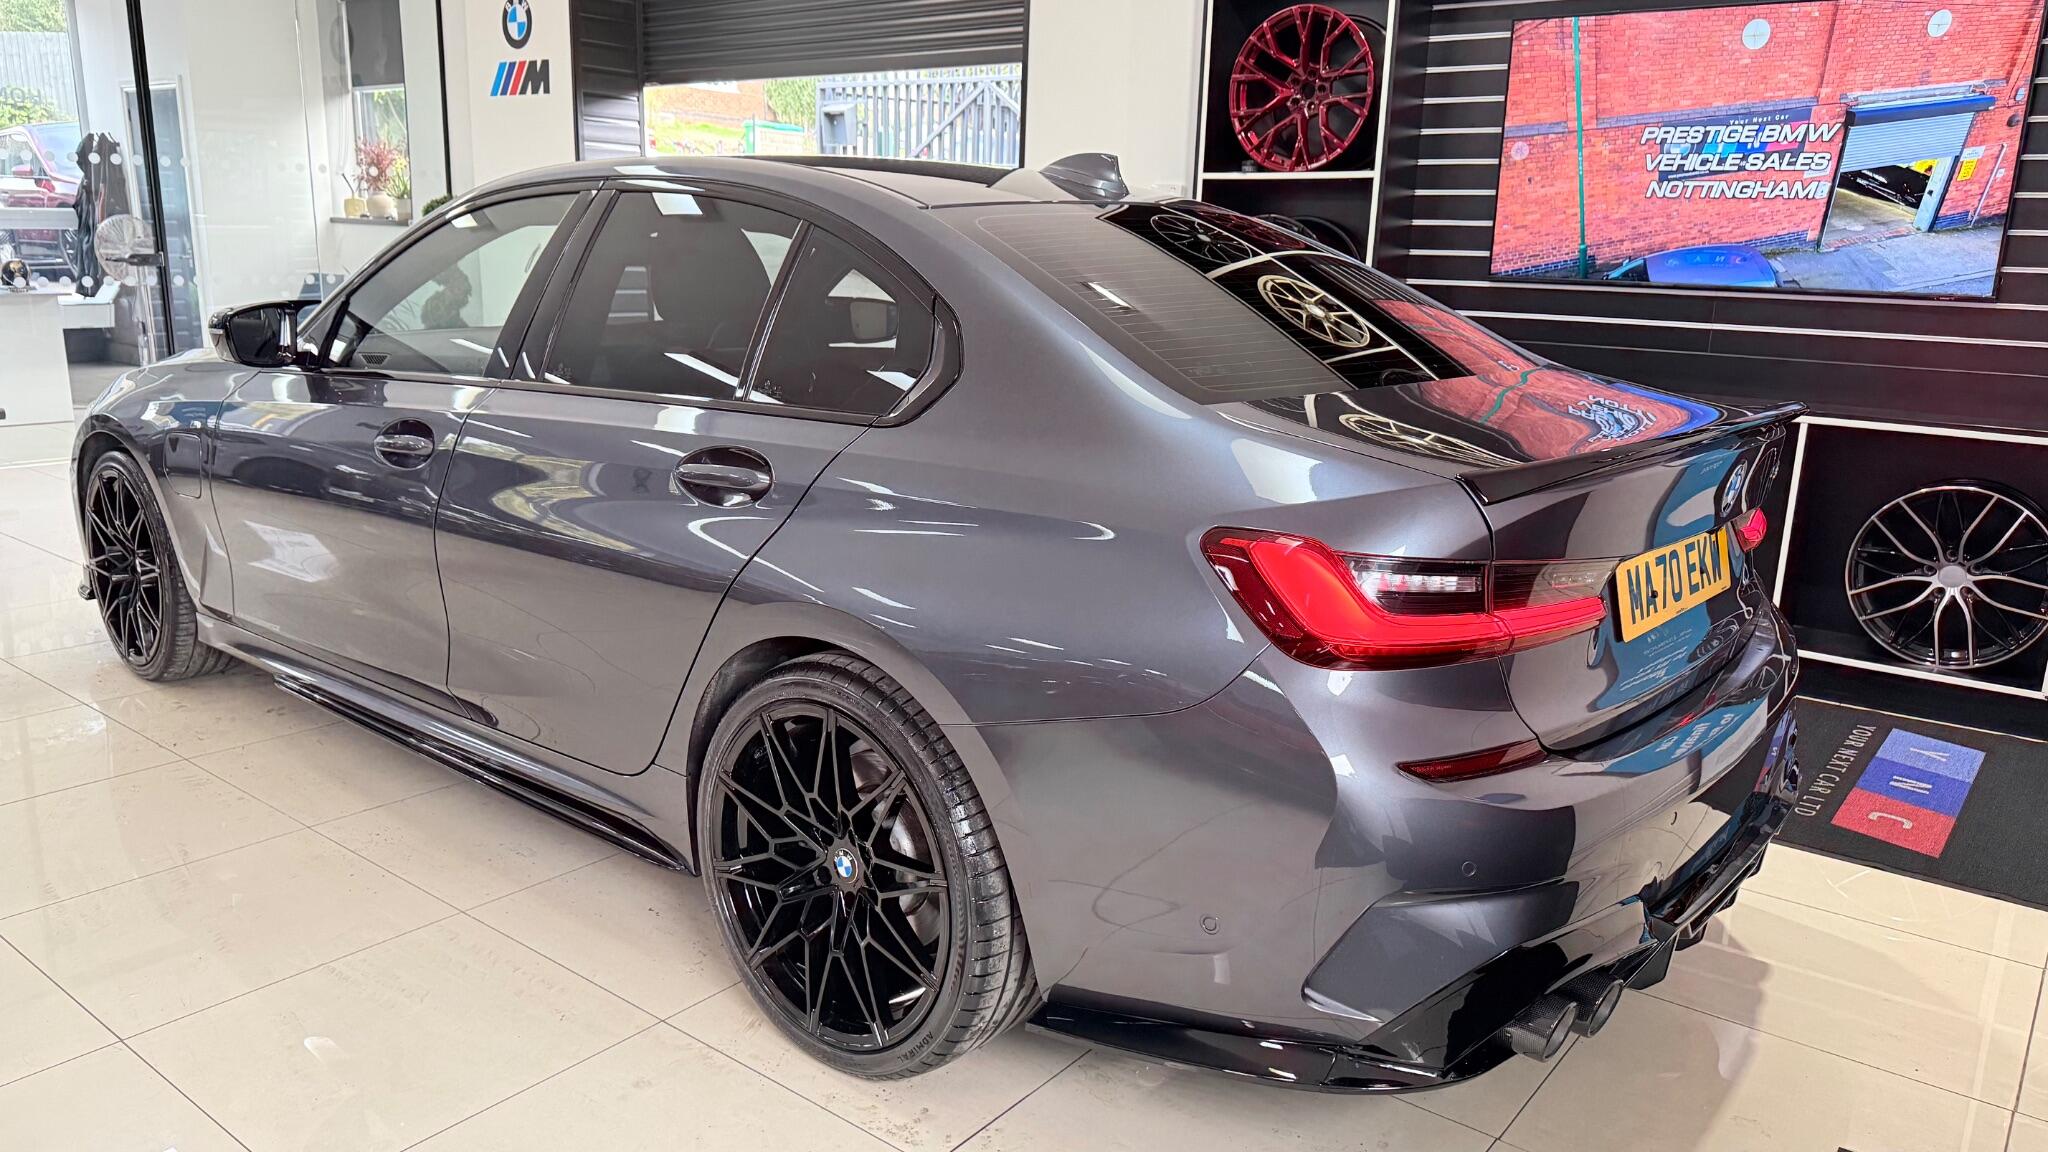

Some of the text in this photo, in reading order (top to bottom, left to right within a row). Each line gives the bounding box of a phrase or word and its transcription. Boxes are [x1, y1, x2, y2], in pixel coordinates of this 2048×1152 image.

[1641, 123, 1842, 144] PRESTIGE BMW
[1646, 152, 1830, 171] VEHICLE SALES
[1646, 181, 1819, 199] NOTTINGHAM
[1626, 534, 1723, 625] MA70 EKW
[1794, 724, 1877, 817] YOUR NEXT CAR LTD
